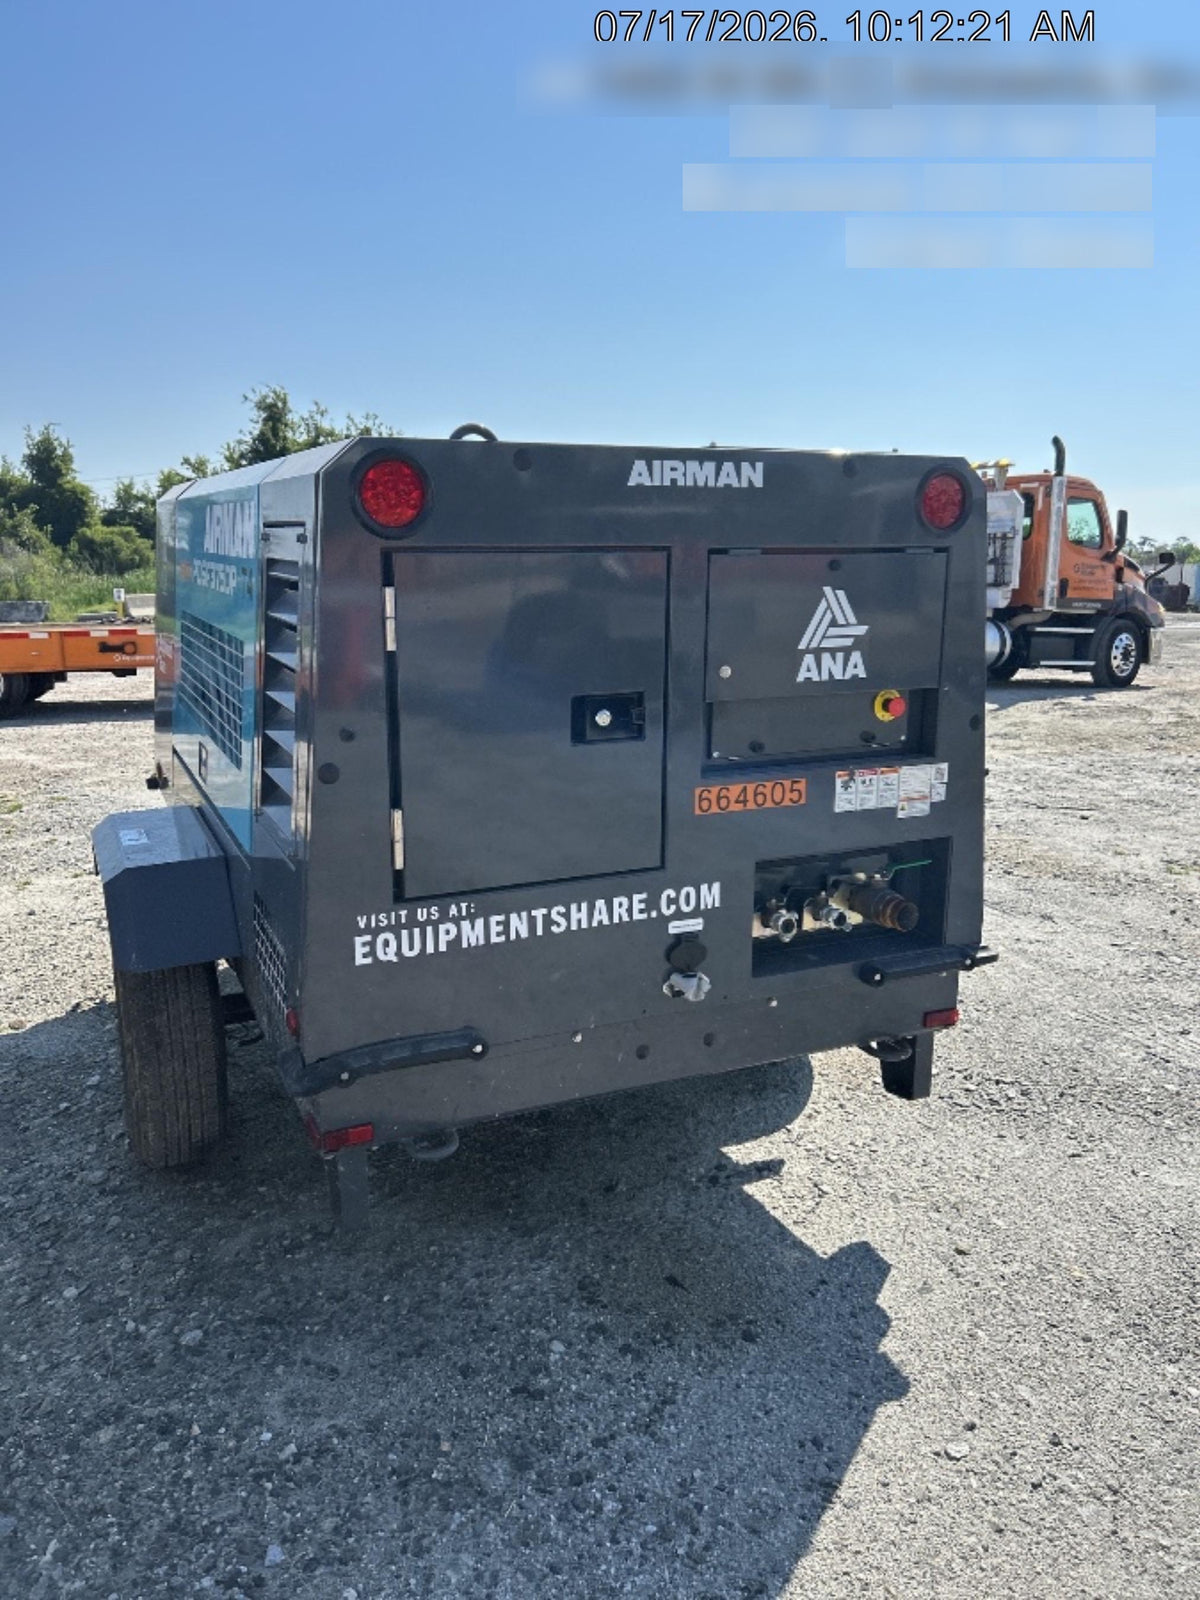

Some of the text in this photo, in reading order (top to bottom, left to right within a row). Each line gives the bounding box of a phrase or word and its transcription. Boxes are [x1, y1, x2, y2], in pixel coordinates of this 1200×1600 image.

[627, 459, 764, 488] AIRMAN
[204, 501, 256, 558] AIRMAN
[796, 650, 867, 683] ANA
[698, 780, 803, 813] 664605
[354, 881, 722, 966] EQUIPMENTSHARE.COM
[356, 902, 476, 929] VISIT US AT:
